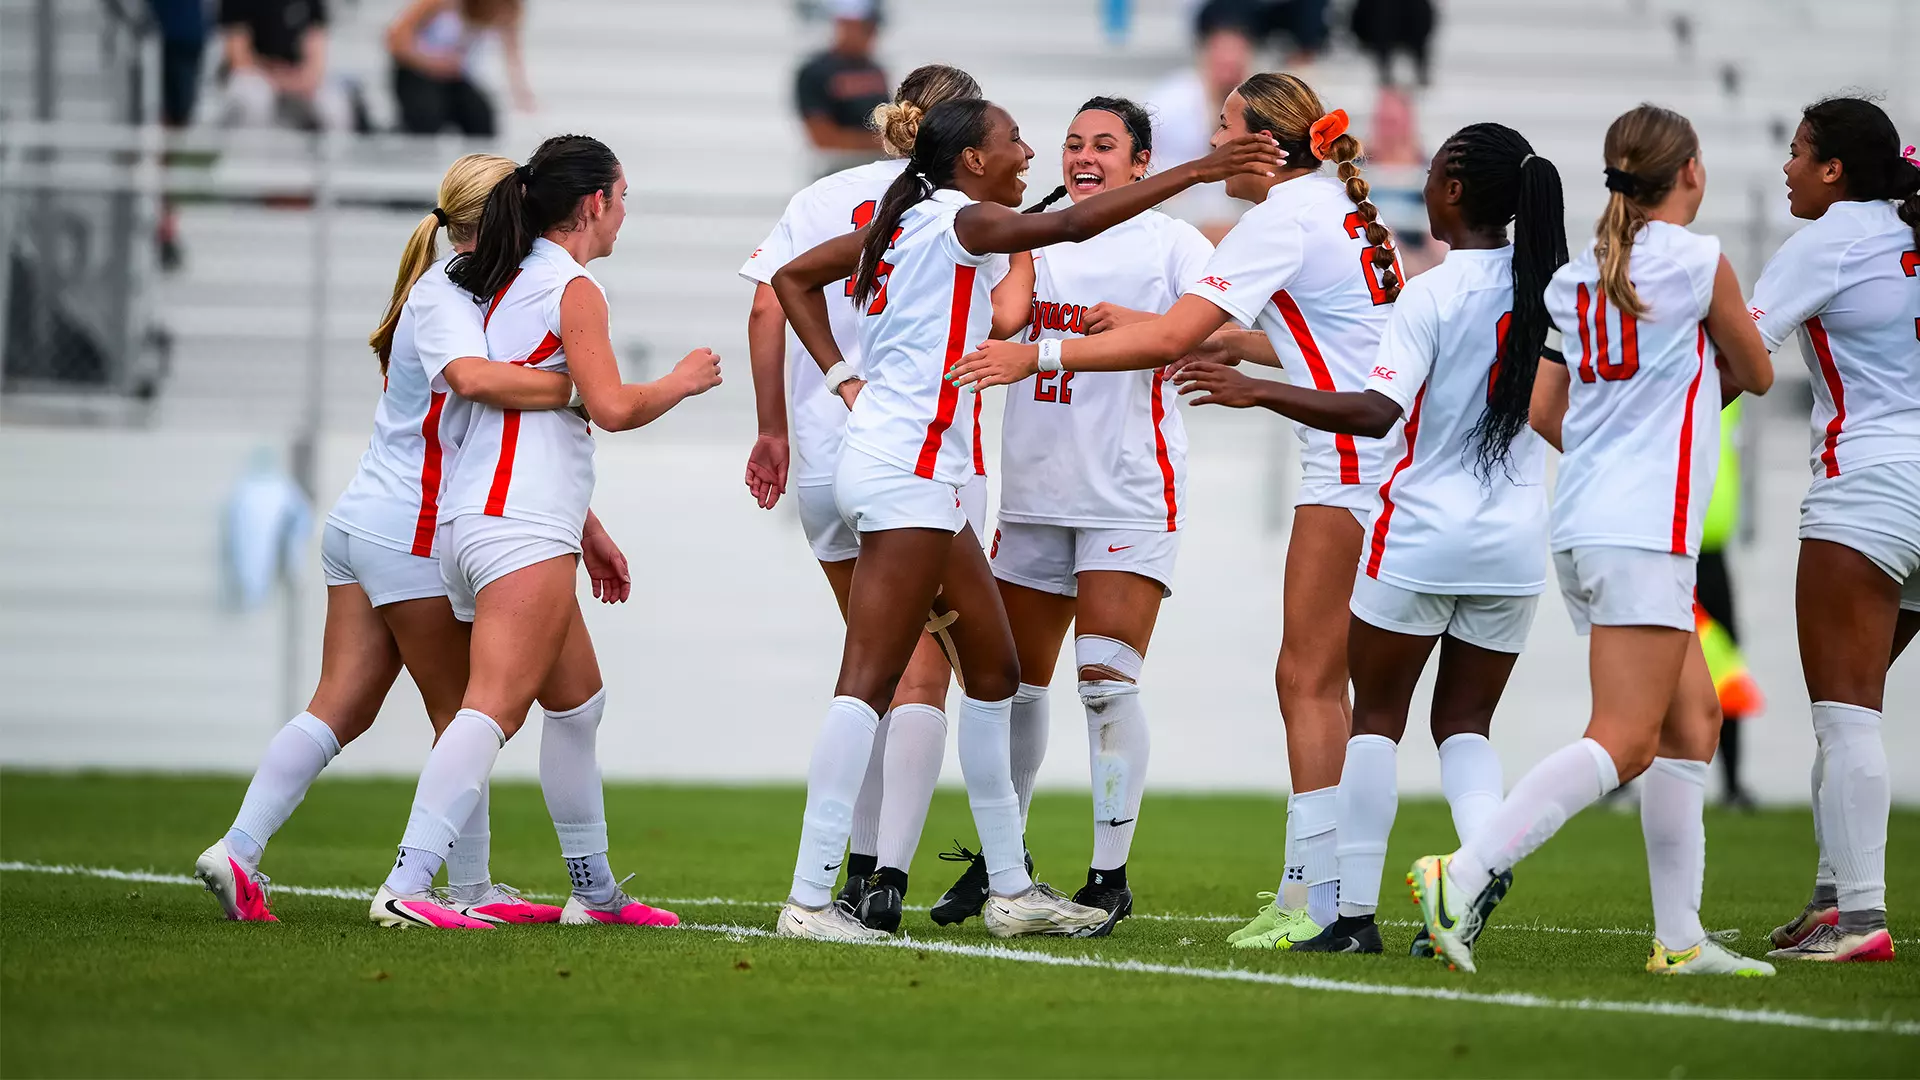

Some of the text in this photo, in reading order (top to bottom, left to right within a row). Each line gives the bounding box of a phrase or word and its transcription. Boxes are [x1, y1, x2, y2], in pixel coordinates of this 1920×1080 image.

[1198, 275, 1232, 292] ACC
[1029, 292, 1088, 342] yracu
[1576, 279, 1640, 383] 10
[1369, 365, 1397, 381] ACC
